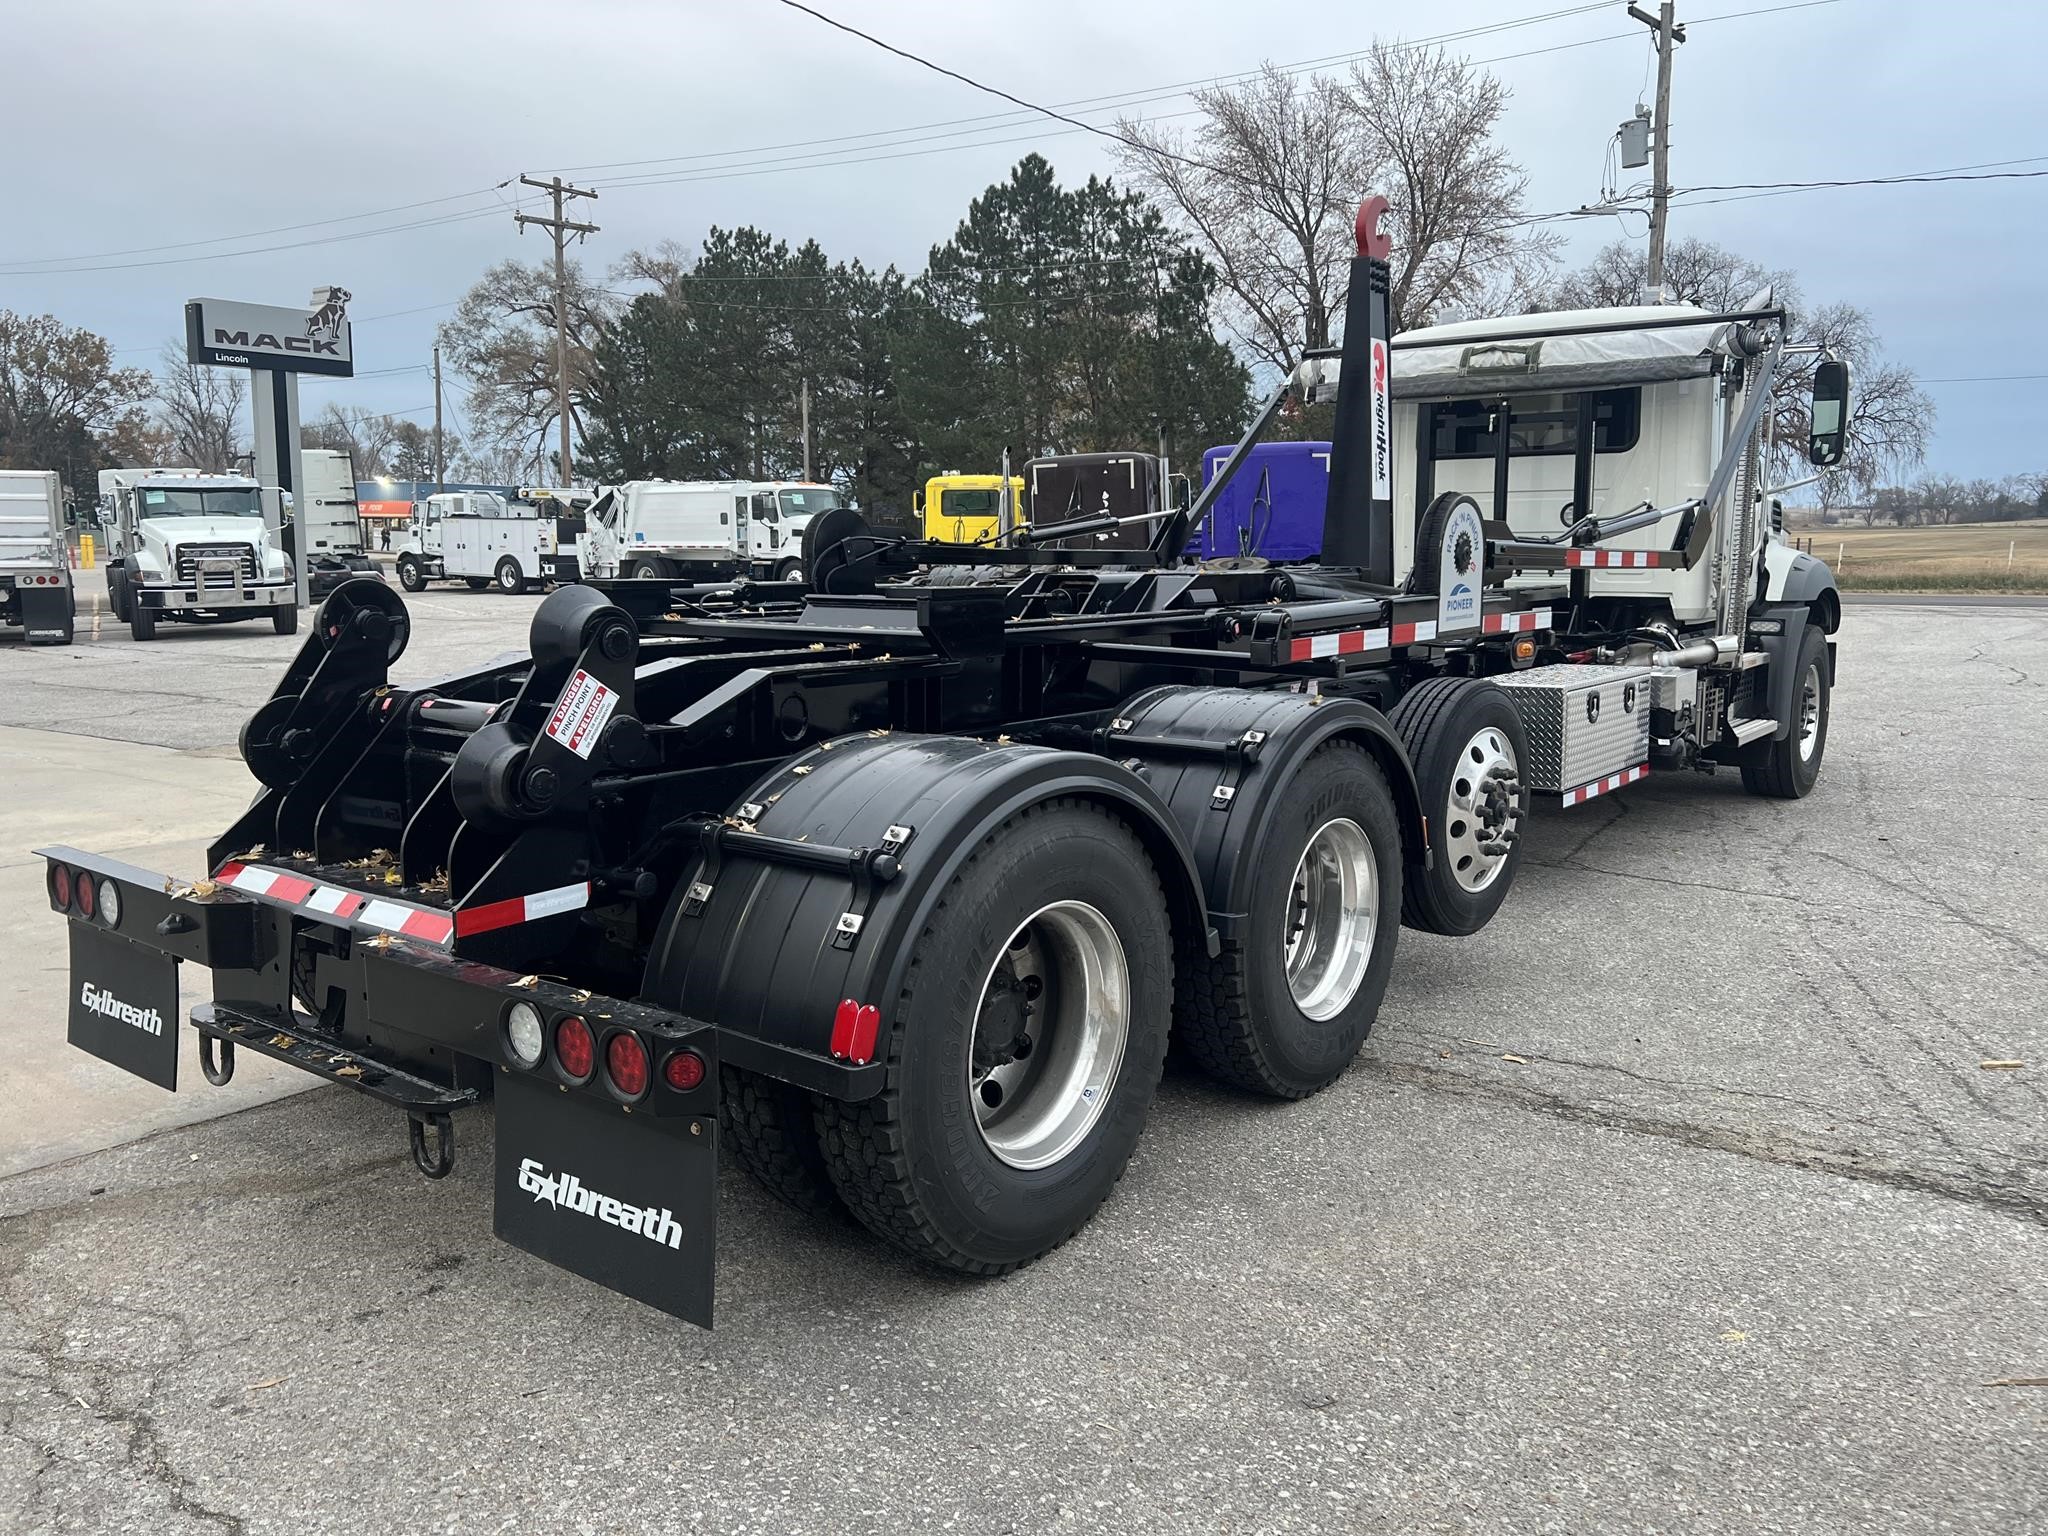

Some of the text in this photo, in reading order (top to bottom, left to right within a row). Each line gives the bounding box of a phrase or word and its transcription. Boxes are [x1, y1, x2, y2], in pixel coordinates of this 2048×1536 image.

[214, 328, 340, 356] MACK
[215, 353, 249, 364] Lincoln
[1375, 393, 1387, 481] RightHook
[1446, 519, 1460, 553] RACK
[1466, 511, 1480, 552] PINION
[1446, 598, 1473, 612] PIONEER
[558, 678, 583, 719] DANGER
[560, 684, 592, 736] PINCH POINT
[577, 692, 603, 735] PELIGRO
